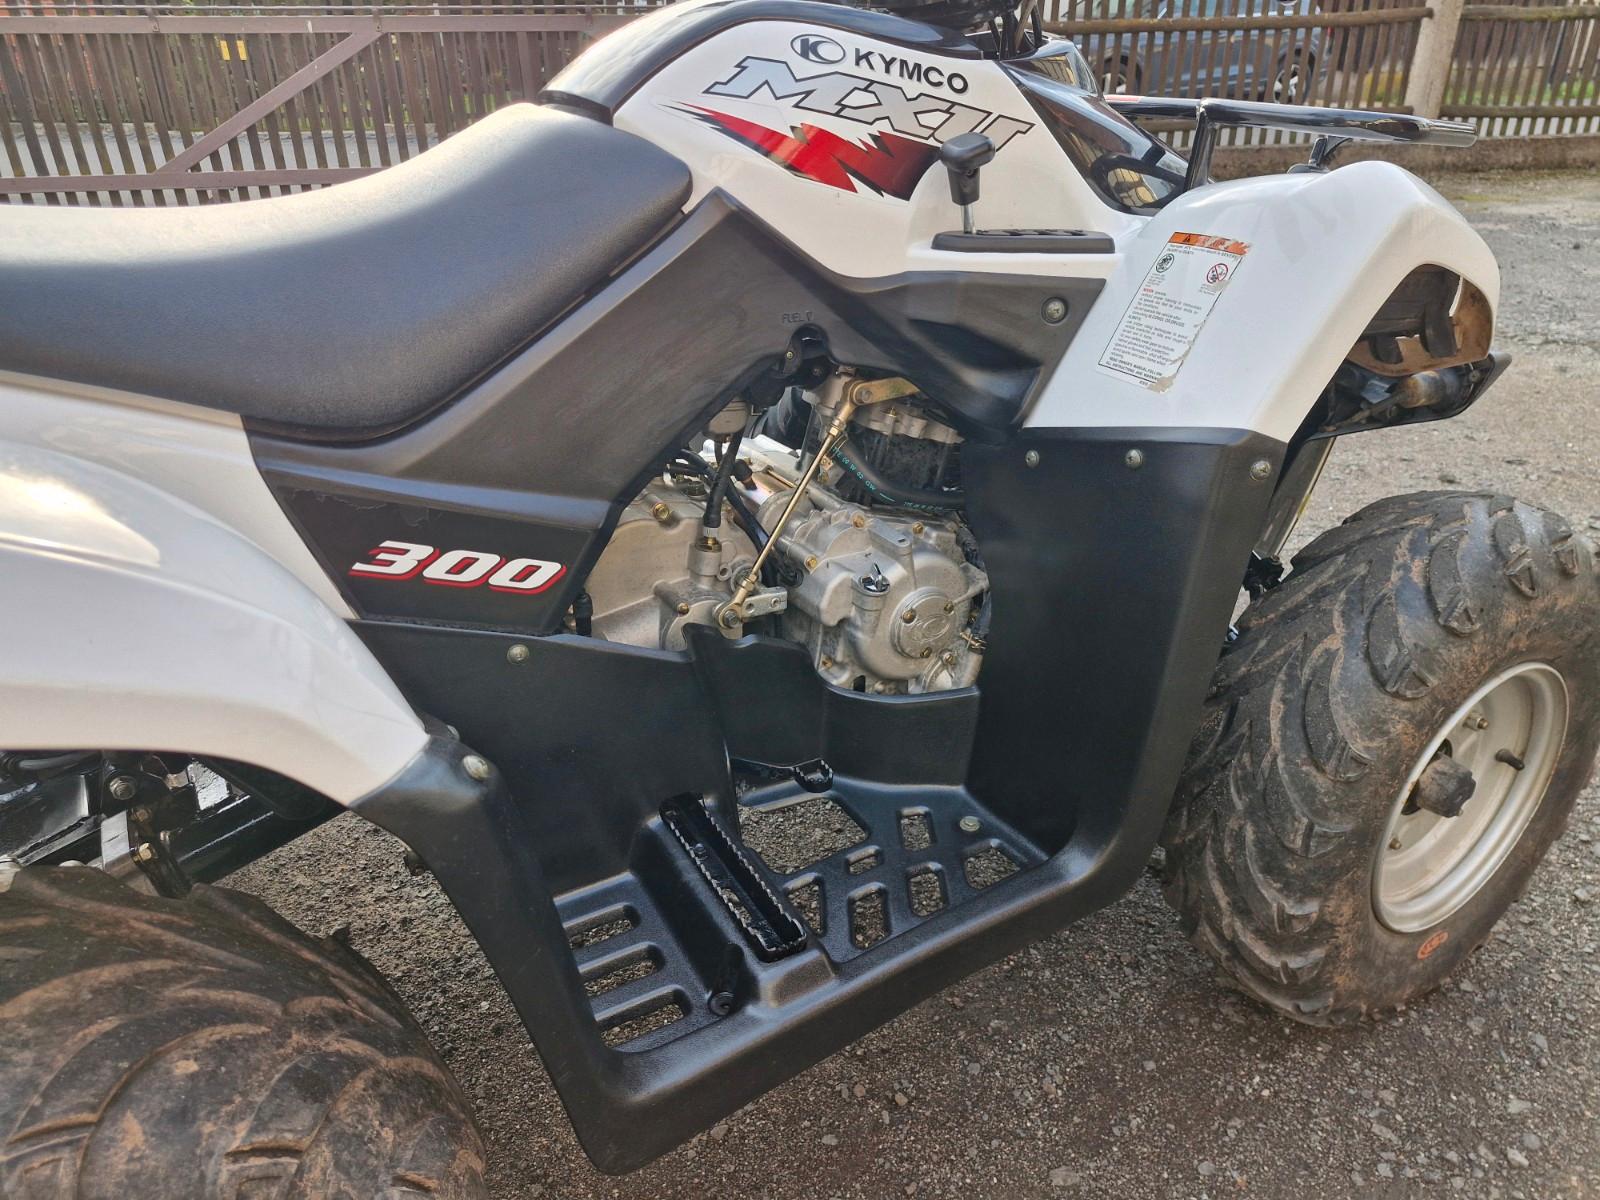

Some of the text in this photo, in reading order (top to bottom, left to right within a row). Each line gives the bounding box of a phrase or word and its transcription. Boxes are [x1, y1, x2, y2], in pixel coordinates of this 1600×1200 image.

[854, 47, 969, 94] KYMCO
[702, 55, 1036, 152] MXU
[782, 312, 805, 324] FUEL
[348, 540, 567, 595] 300
